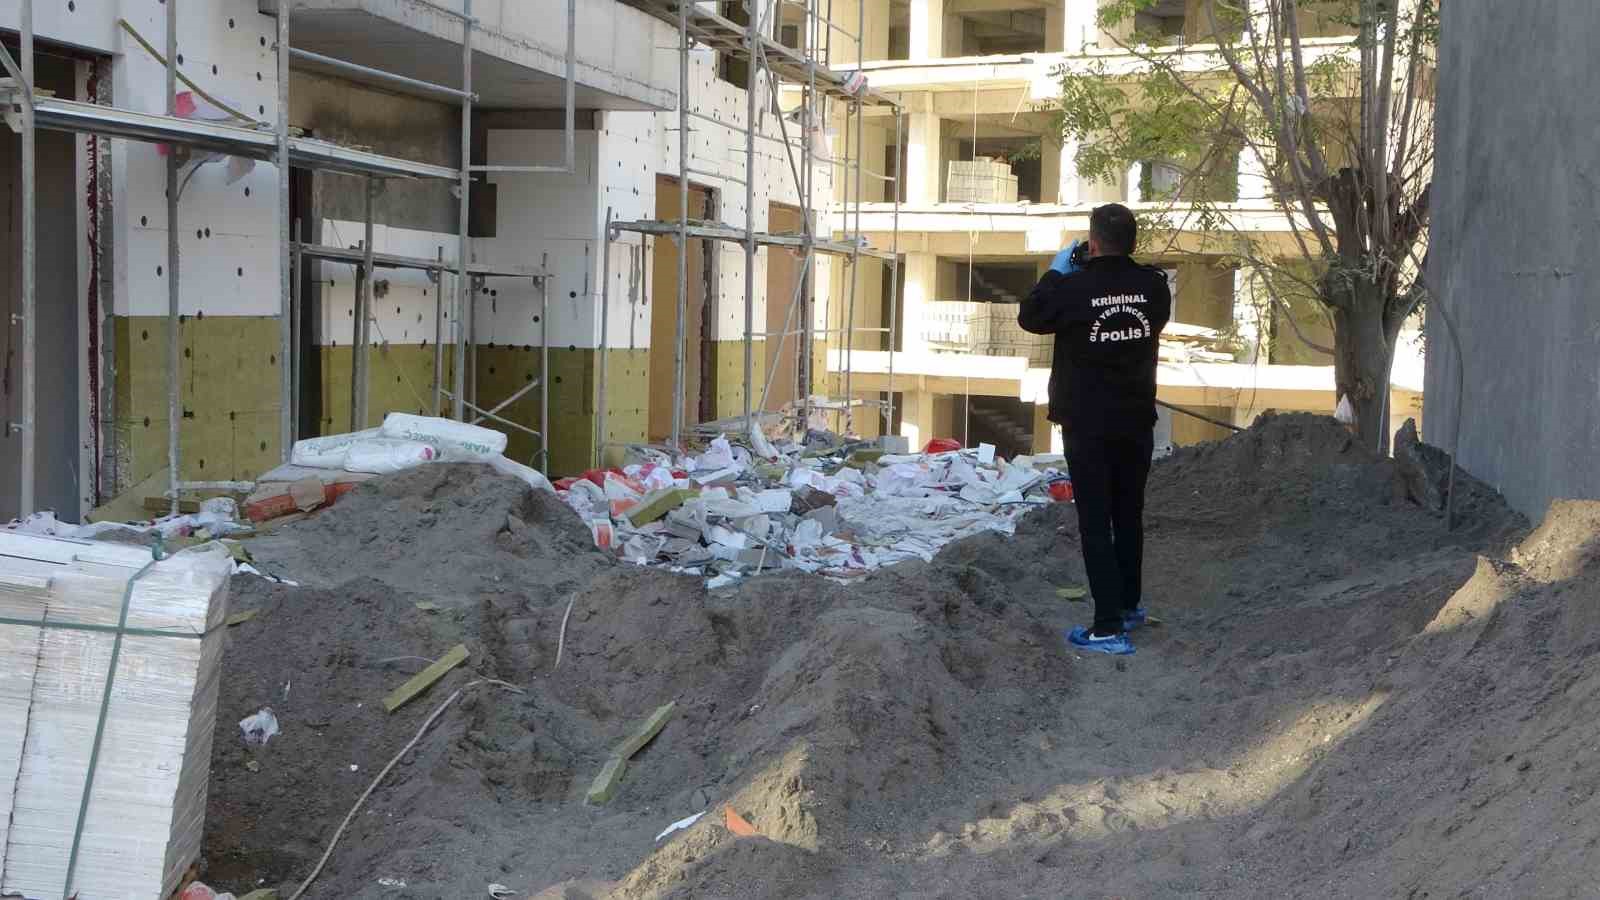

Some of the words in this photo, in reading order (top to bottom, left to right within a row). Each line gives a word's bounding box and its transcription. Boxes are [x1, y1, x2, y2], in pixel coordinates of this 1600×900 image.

[1091, 294, 1147, 307] KRİMİNAL
[1089, 320, 1101, 342] OLAY
[1100, 327, 1143, 342] POLİS
